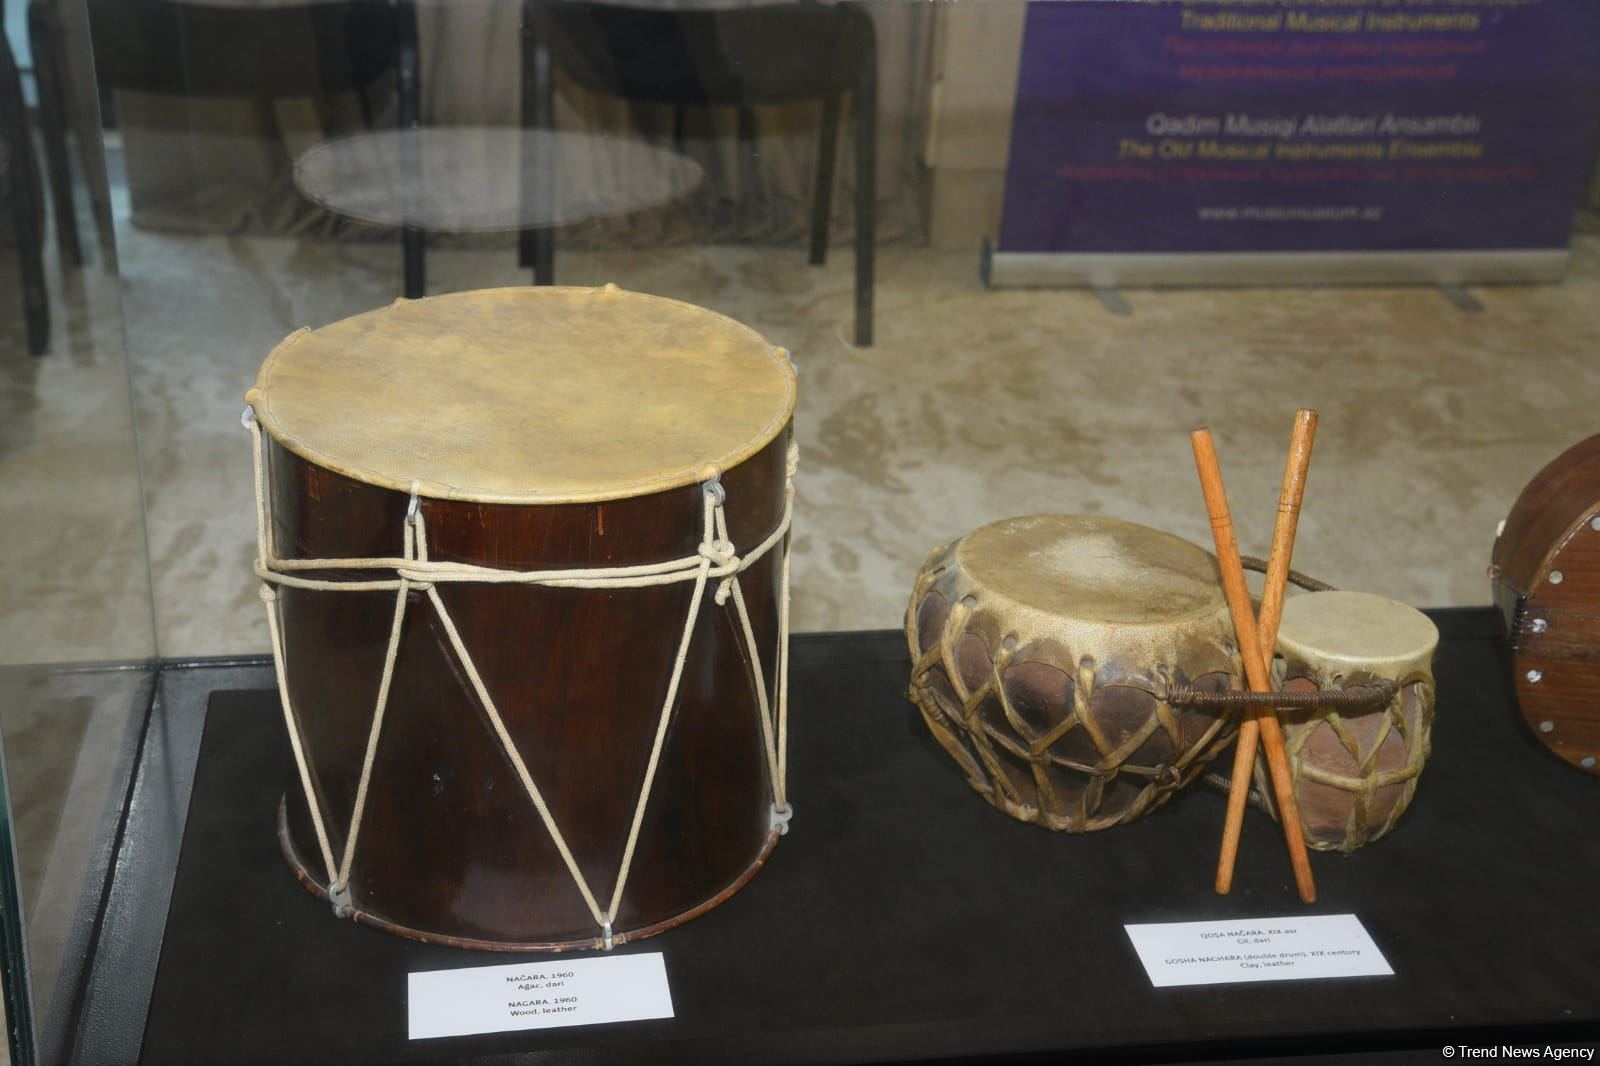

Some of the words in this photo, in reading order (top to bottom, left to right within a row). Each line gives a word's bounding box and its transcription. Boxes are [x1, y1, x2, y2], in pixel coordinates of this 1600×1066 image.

[1286, 10, 1362, 31] Musical
[1327, 948, 1361, 957] century
[552, 971, 574, 979] 1960
[554, 996, 577, 1004] 1960
[542, 1005, 577, 1014] leather
